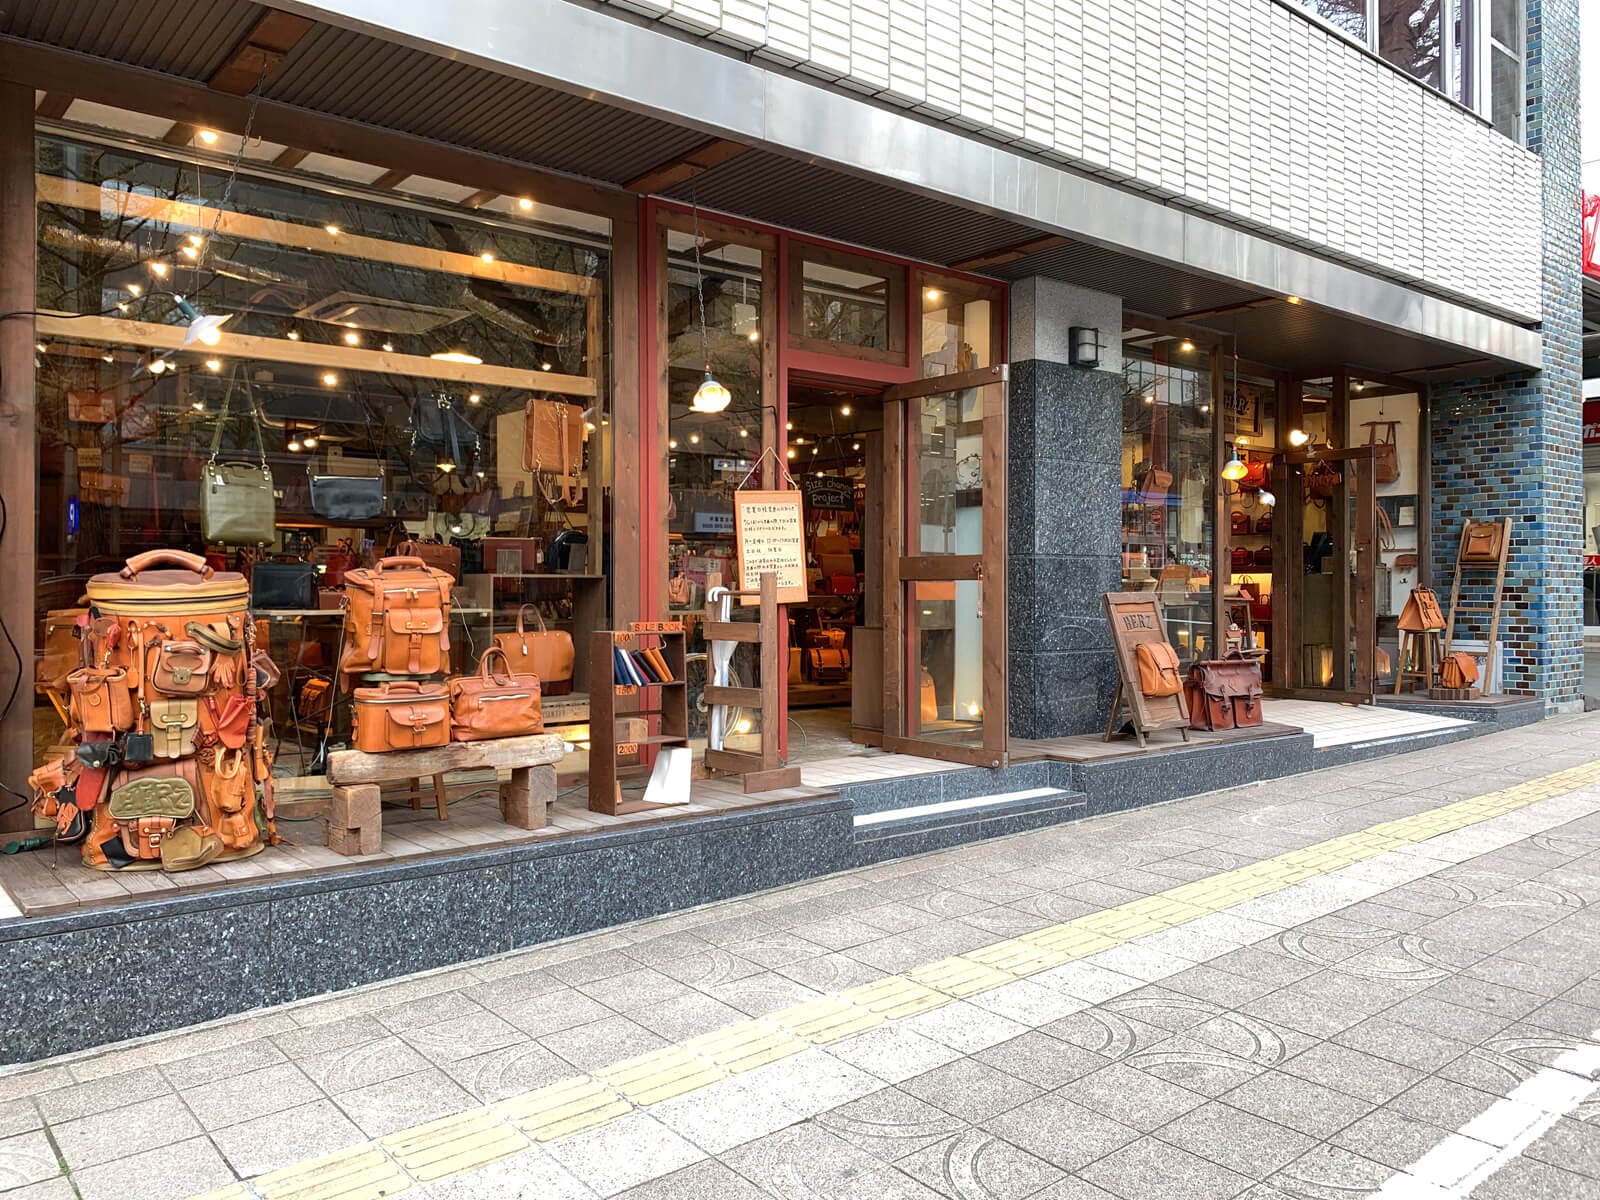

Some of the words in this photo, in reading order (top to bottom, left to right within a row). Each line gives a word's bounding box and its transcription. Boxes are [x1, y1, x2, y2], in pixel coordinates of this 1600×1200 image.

[805, 477, 823, 491] Size
[812, 492, 845, 506] project
[634, 623, 655, 631] SALE
[658, 623, 680, 631] BOOK
[1122, 613, 1153, 630] HERZ
[618, 745, 637, 754] 2000
[121, 783, 190, 812] HERZ
